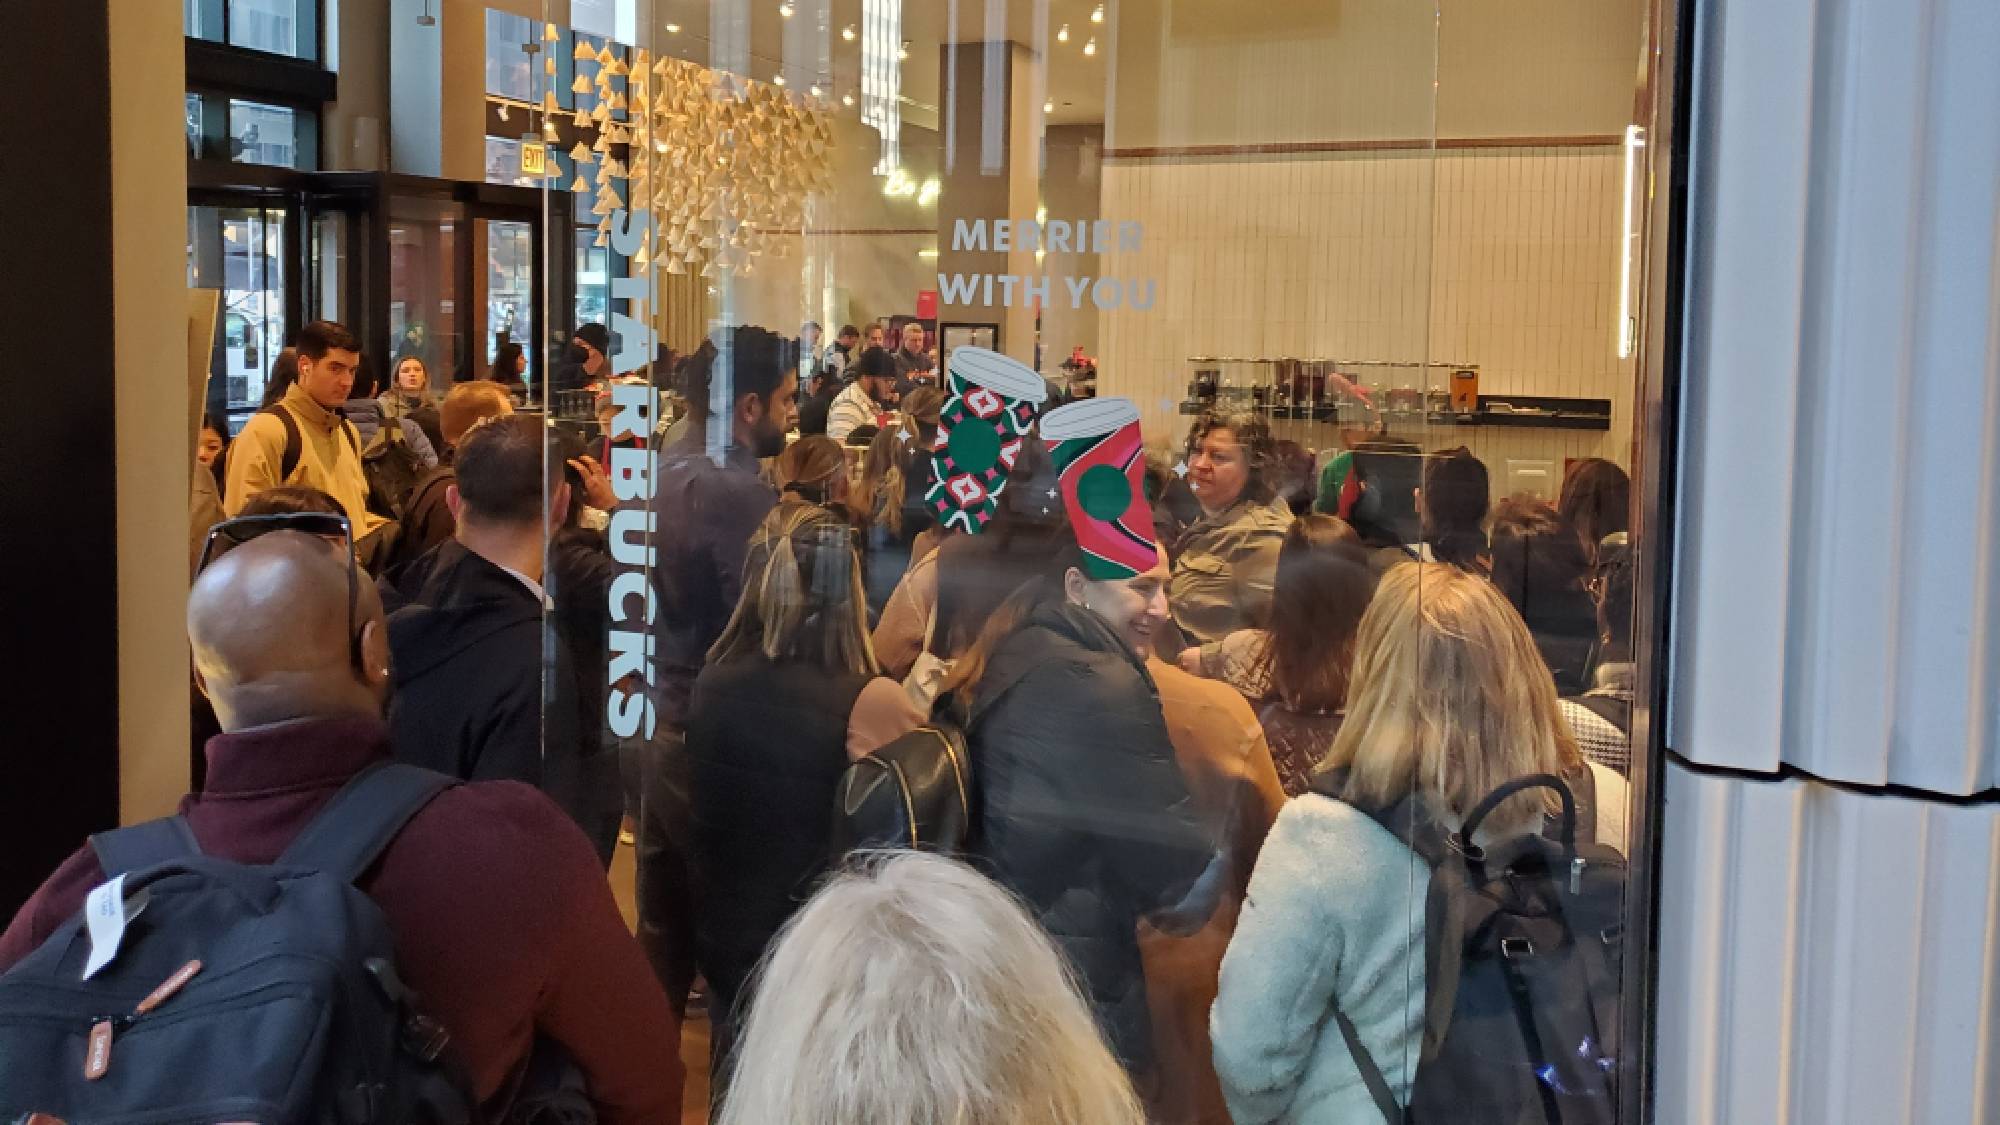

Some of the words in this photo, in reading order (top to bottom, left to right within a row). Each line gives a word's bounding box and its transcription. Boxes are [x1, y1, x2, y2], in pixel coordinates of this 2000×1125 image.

[523, 146, 544, 168] EXIT
[951, 218, 1144, 253] MERRIER
[937, 272, 1050, 309] WITH
[1064, 275, 1157, 311] YOU
[608, 207, 658, 740] STARBUCKS
